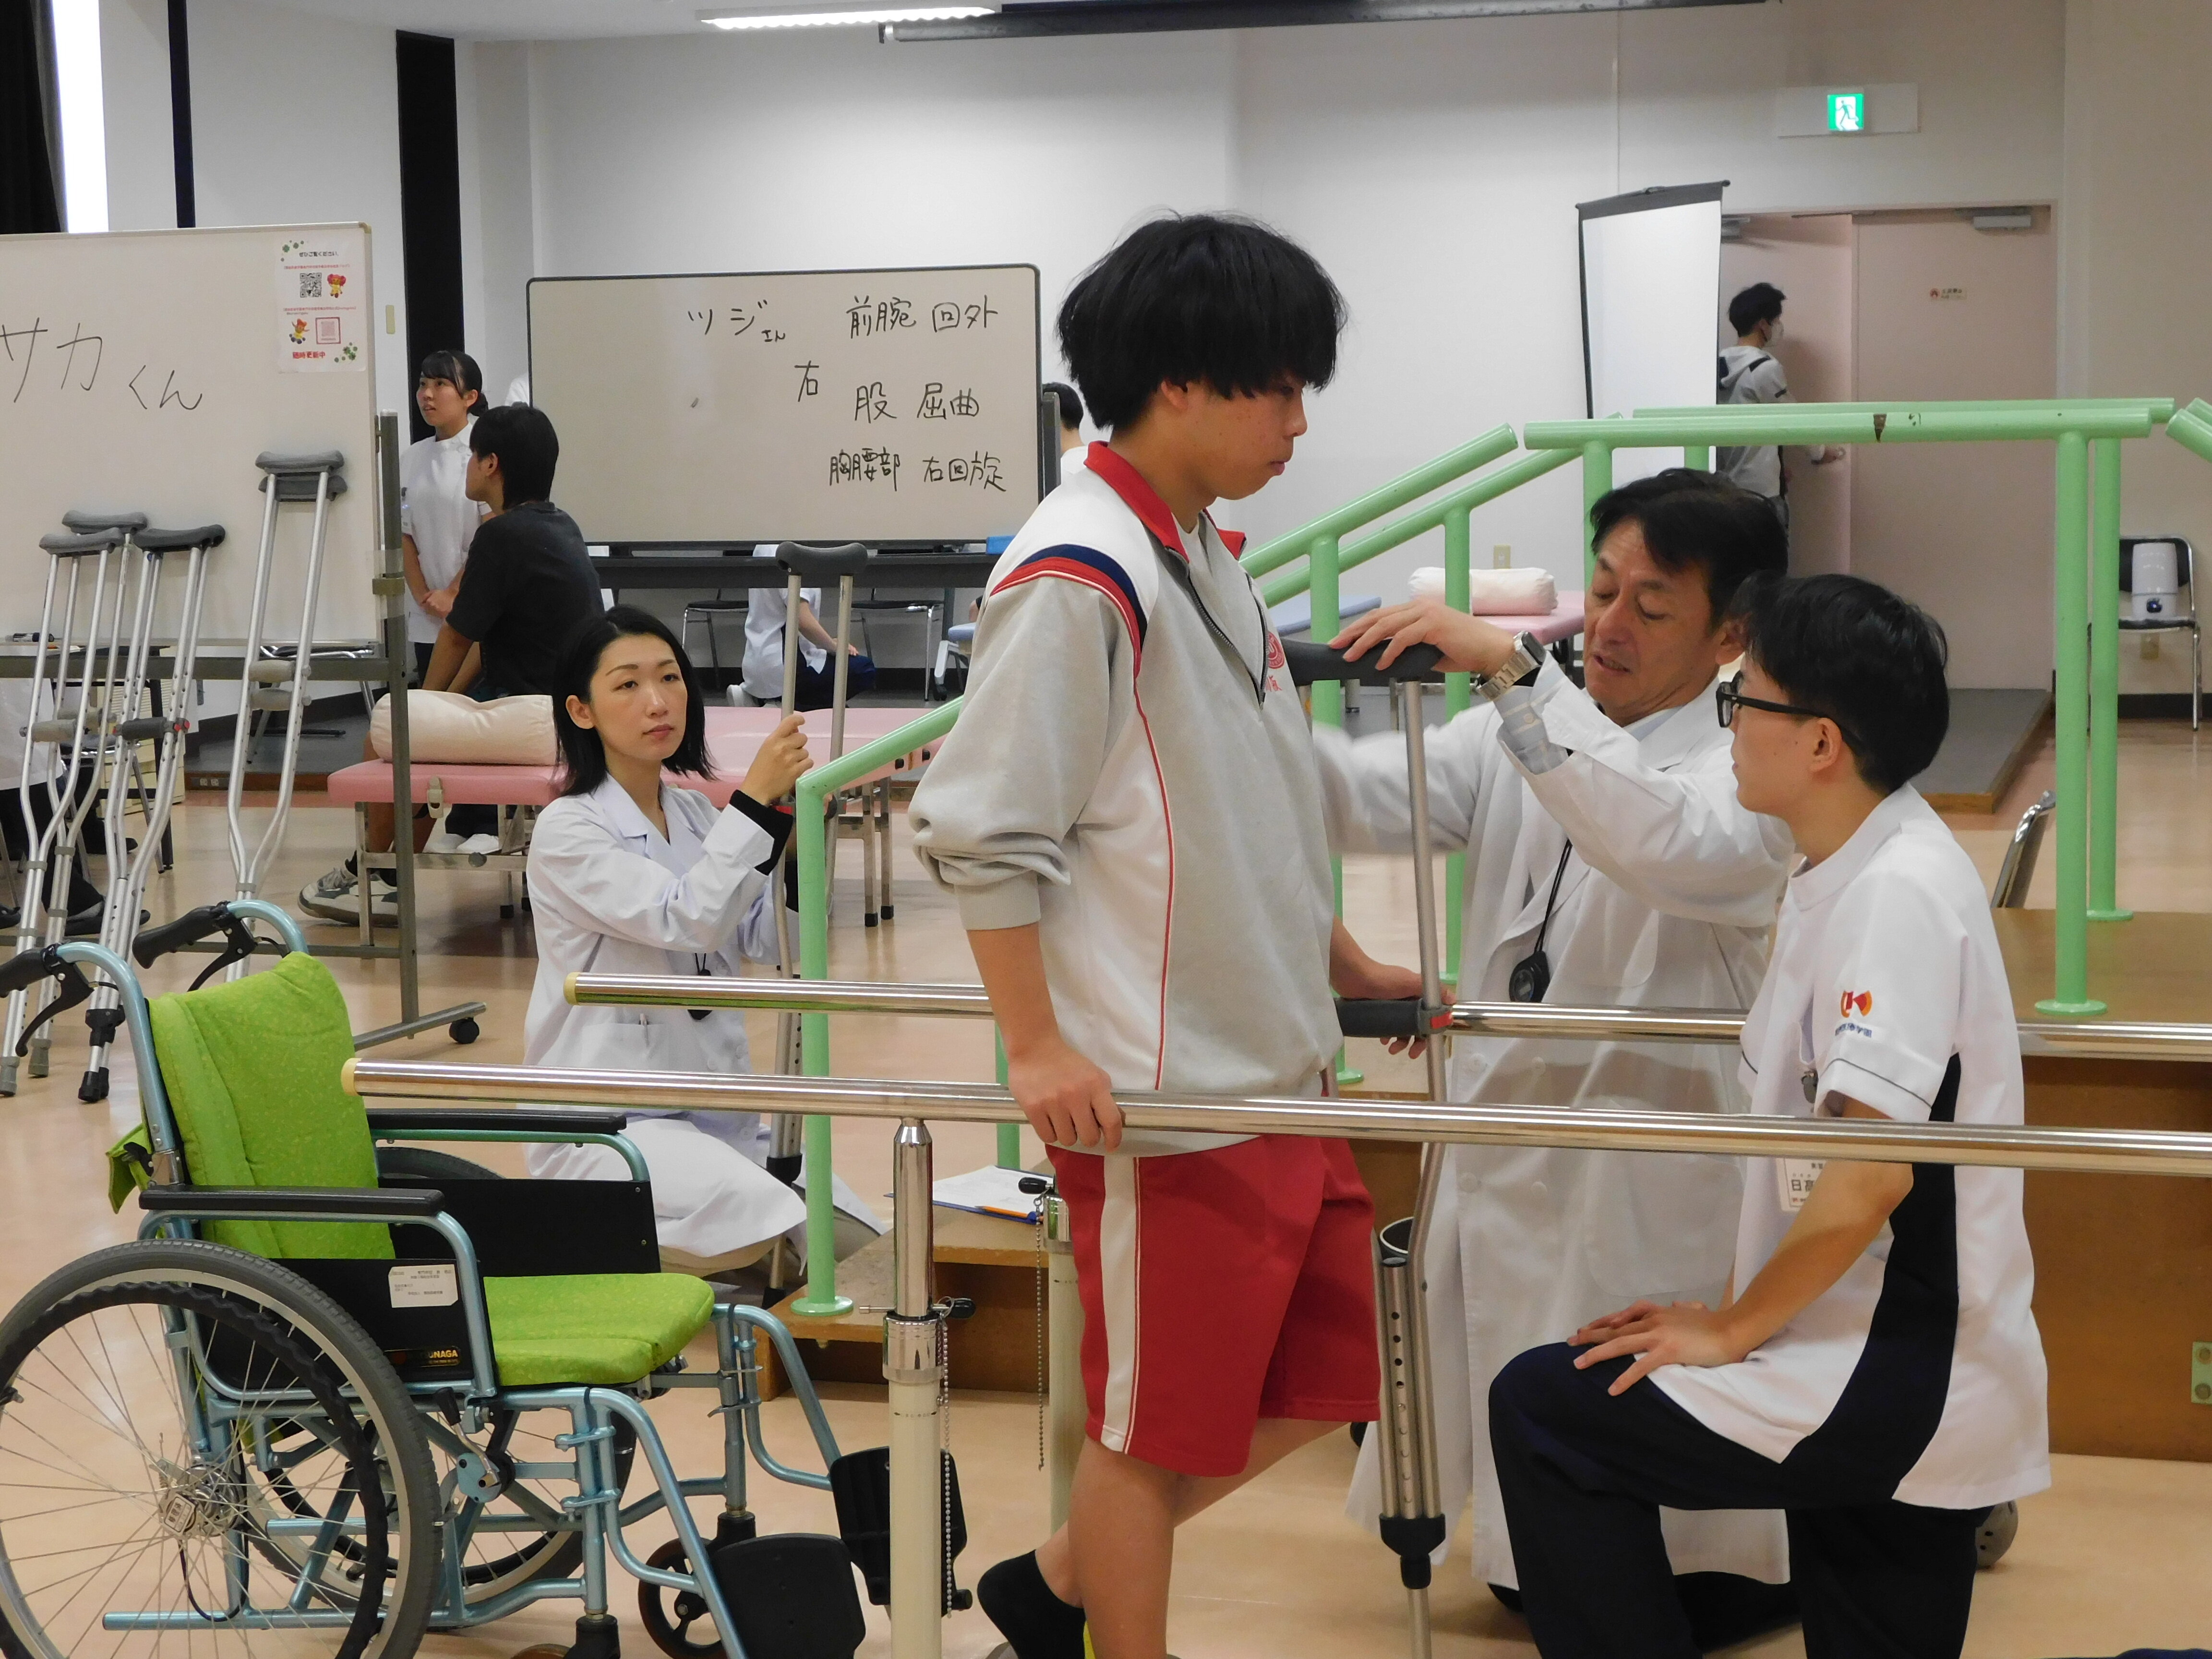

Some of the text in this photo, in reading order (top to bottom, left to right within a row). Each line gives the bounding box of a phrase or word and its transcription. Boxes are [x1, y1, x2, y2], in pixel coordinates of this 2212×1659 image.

[846, 294, 998, 339] 前腕 回外
[793, 360, 980, 424] 右 股 屈曲
[922, 450, 1007, 492] 右回旋
